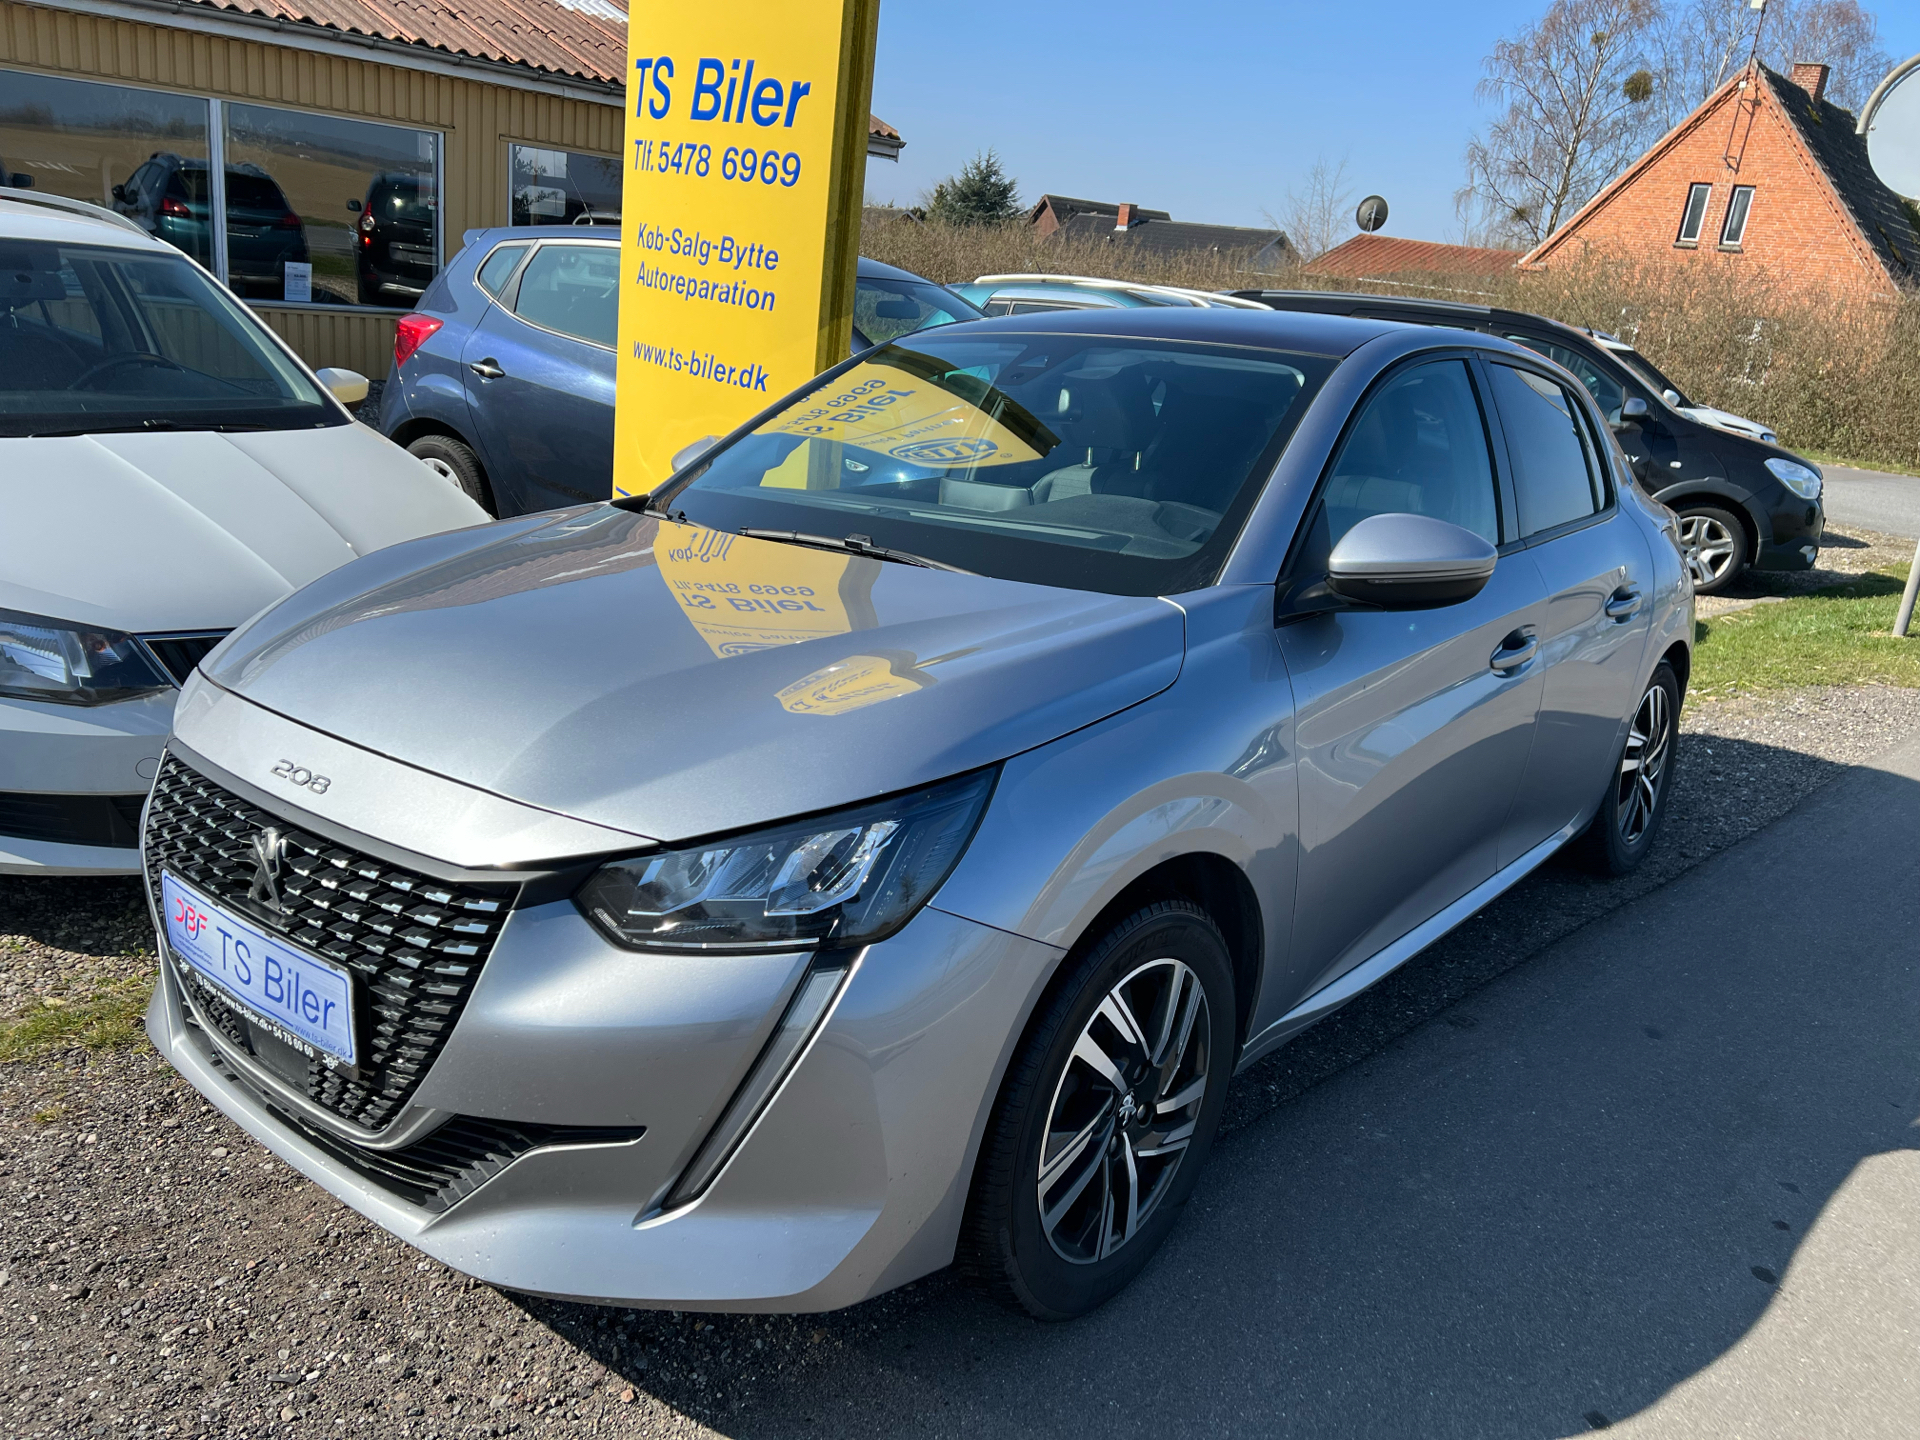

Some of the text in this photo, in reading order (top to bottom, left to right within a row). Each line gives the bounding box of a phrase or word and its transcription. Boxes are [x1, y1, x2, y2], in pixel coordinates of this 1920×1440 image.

[635, 56, 811, 128] TS Biler
[721, 146, 801, 187] 6969
[637, 222, 779, 270] Køb-Salg-Bytte
[636, 261, 776, 311] Autoreparation
[633, 340, 770, 392] www.ts-biler.dk
[270, 758, 331, 795] 208
[216, 926, 252, 986] TS
[264, 955, 336, 1031] Biler
[294, 1024, 348, 1059] www.ts-biler.dk
